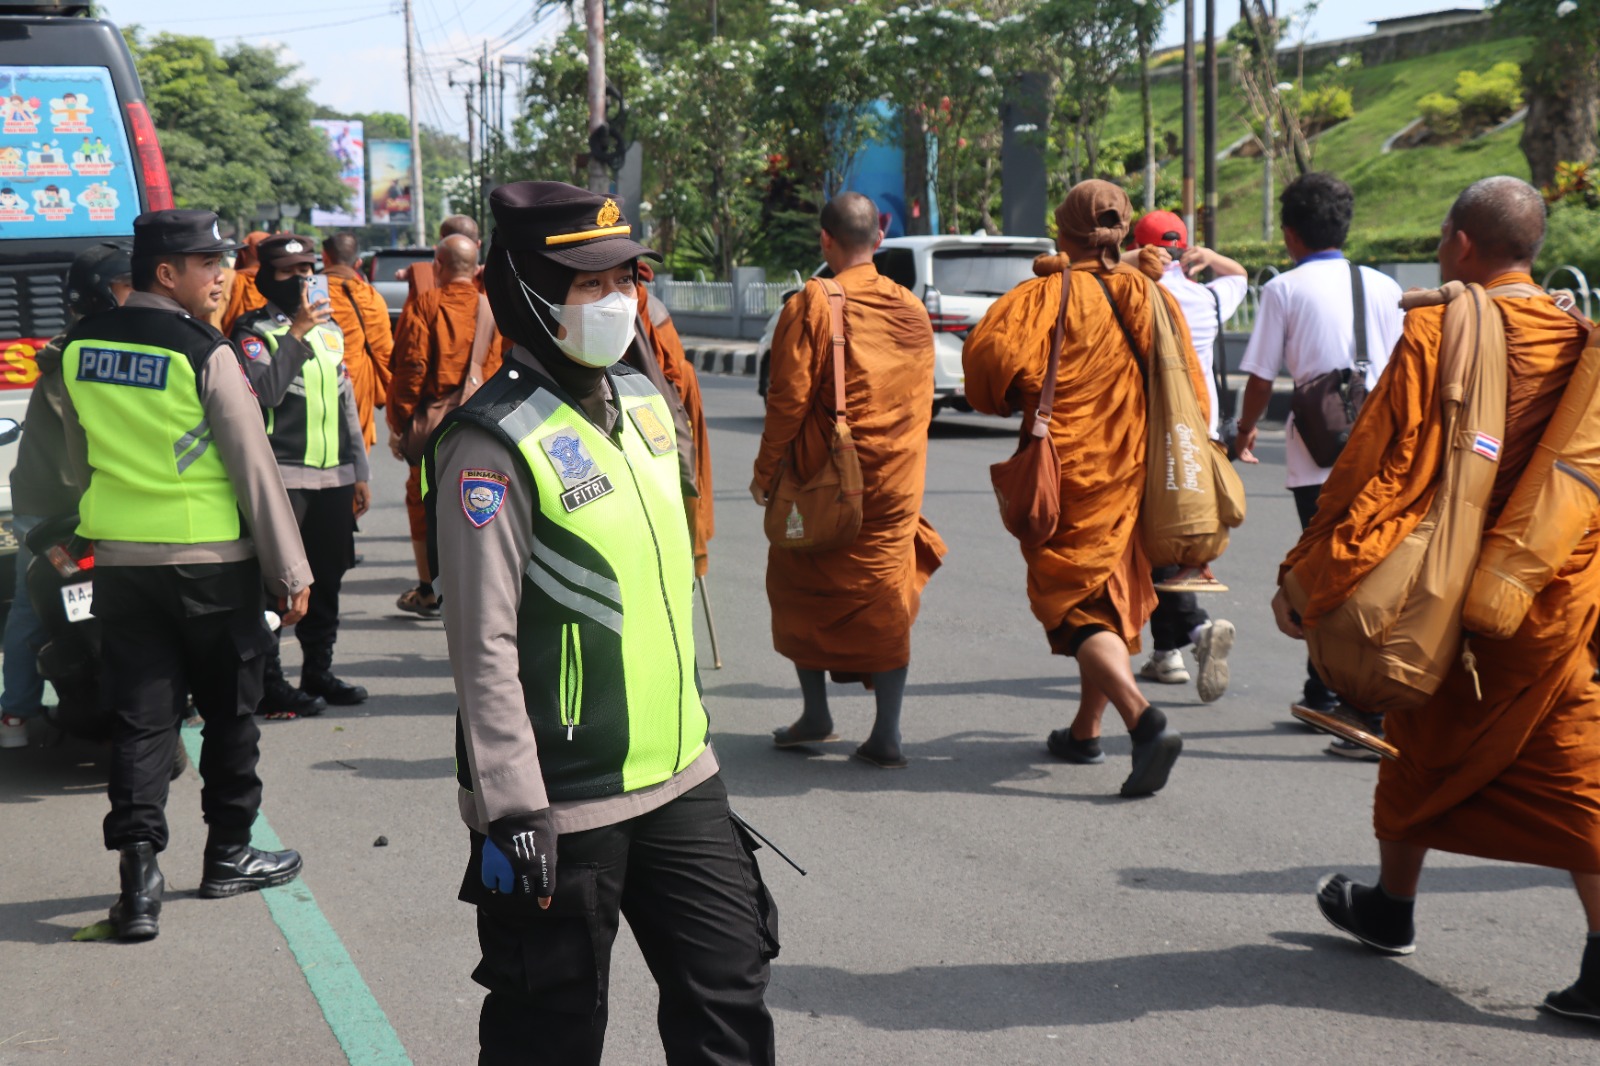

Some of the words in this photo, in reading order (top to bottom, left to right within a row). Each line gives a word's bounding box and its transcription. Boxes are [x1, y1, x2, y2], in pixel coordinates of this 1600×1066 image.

[4, 343, 46, 384] S
[80, 350, 166, 387] POLISI
[572, 481, 606, 505] FITRI
